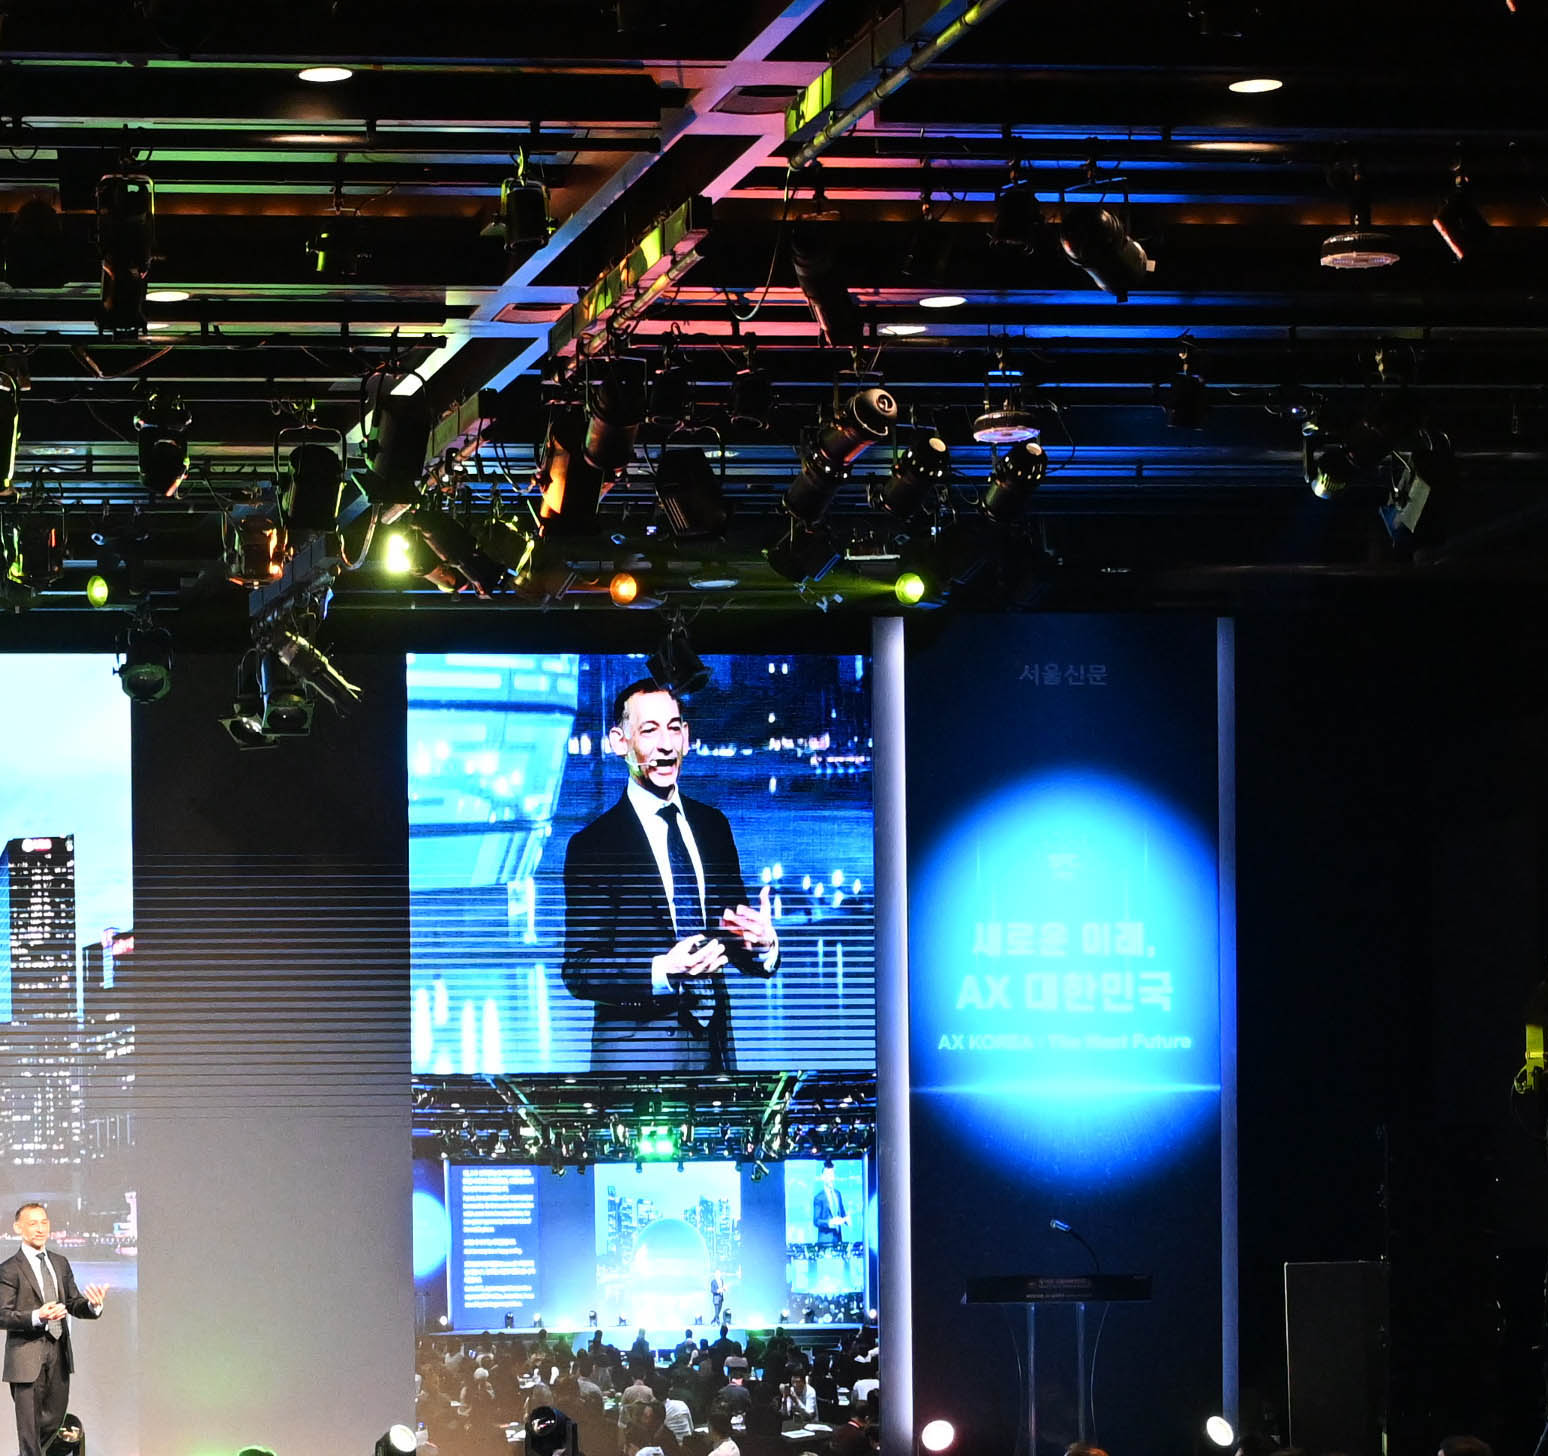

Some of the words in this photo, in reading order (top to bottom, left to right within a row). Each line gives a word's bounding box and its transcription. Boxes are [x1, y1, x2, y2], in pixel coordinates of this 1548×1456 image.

[1018, 662, 1110, 687] 서울신문
[972, 921, 1069, 958] 새로운
[1081, 921, 1158, 959] 미래,
[956, 974, 1012, 1010] AX
[1024, 971, 1174, 1013] 대한민국
[938, 1034, 963, 1050] AX
